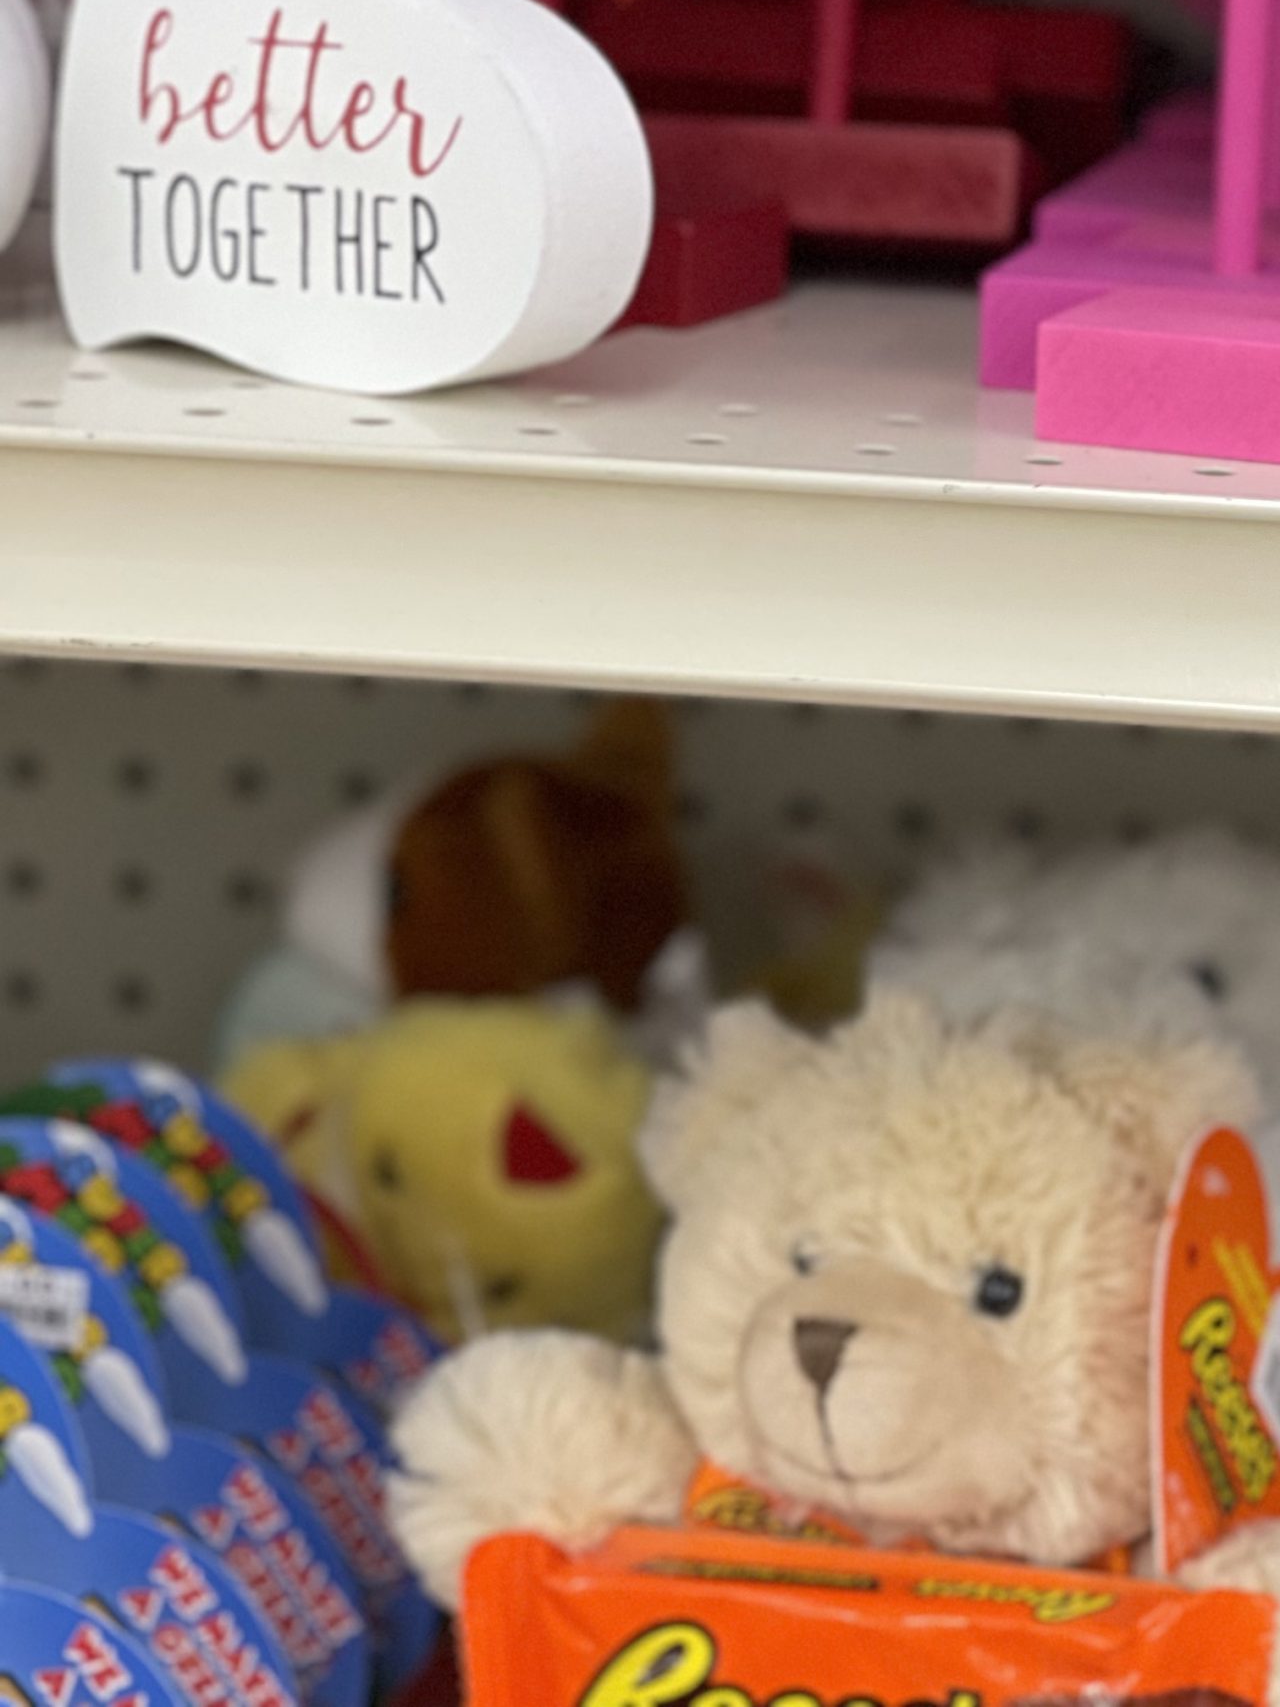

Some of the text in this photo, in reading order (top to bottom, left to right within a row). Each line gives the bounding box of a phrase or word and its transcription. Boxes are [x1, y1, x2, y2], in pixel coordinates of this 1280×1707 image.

[140, 8, 463, 178] better
[117, 167, 445, 304] TOGETHER
[117, 1585, 168, 1634] A
[148, 1538, 220, 1624] WE
[62, 1619, 134, 1702] WE
